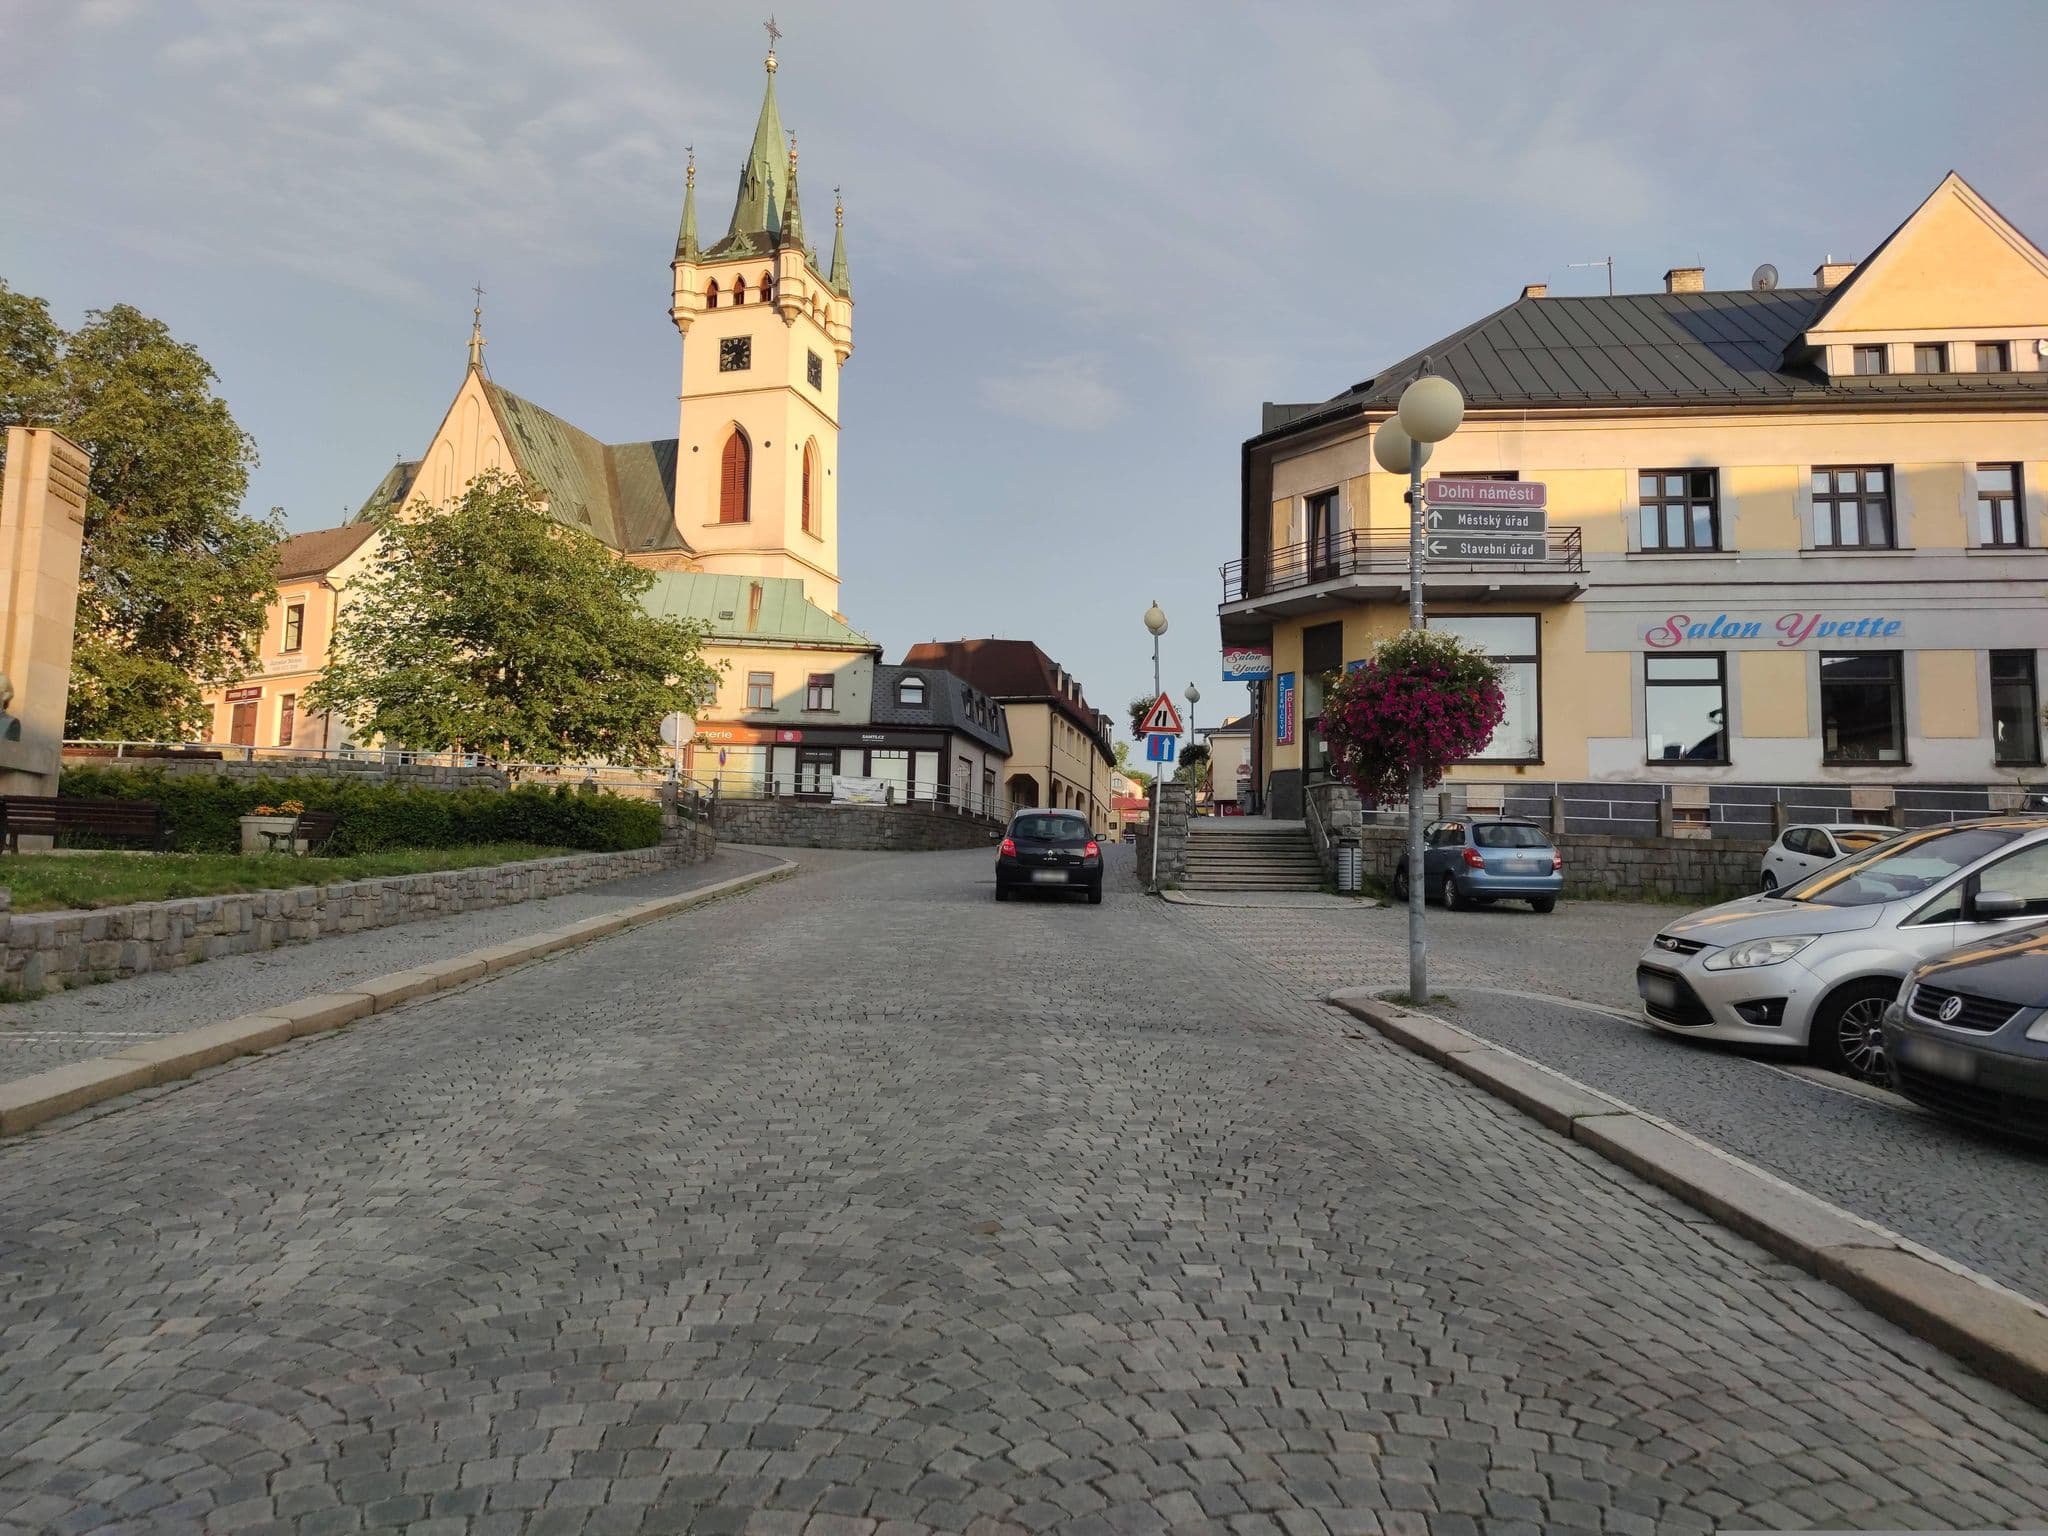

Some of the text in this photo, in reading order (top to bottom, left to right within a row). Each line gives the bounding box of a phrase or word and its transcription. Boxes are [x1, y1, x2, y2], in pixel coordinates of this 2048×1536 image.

[1438, 484, 1534, 501] Dolní náměstí
[1458, 513, 1529, 529] Městský úřad
[1460, 542, 1534, 555] Stavební úřad
[1645, 612, 1902, 648] Salon Yvette
[1226, 651, 1262, 664] Salon
[1232, 664, 1271, 675] Yvette
